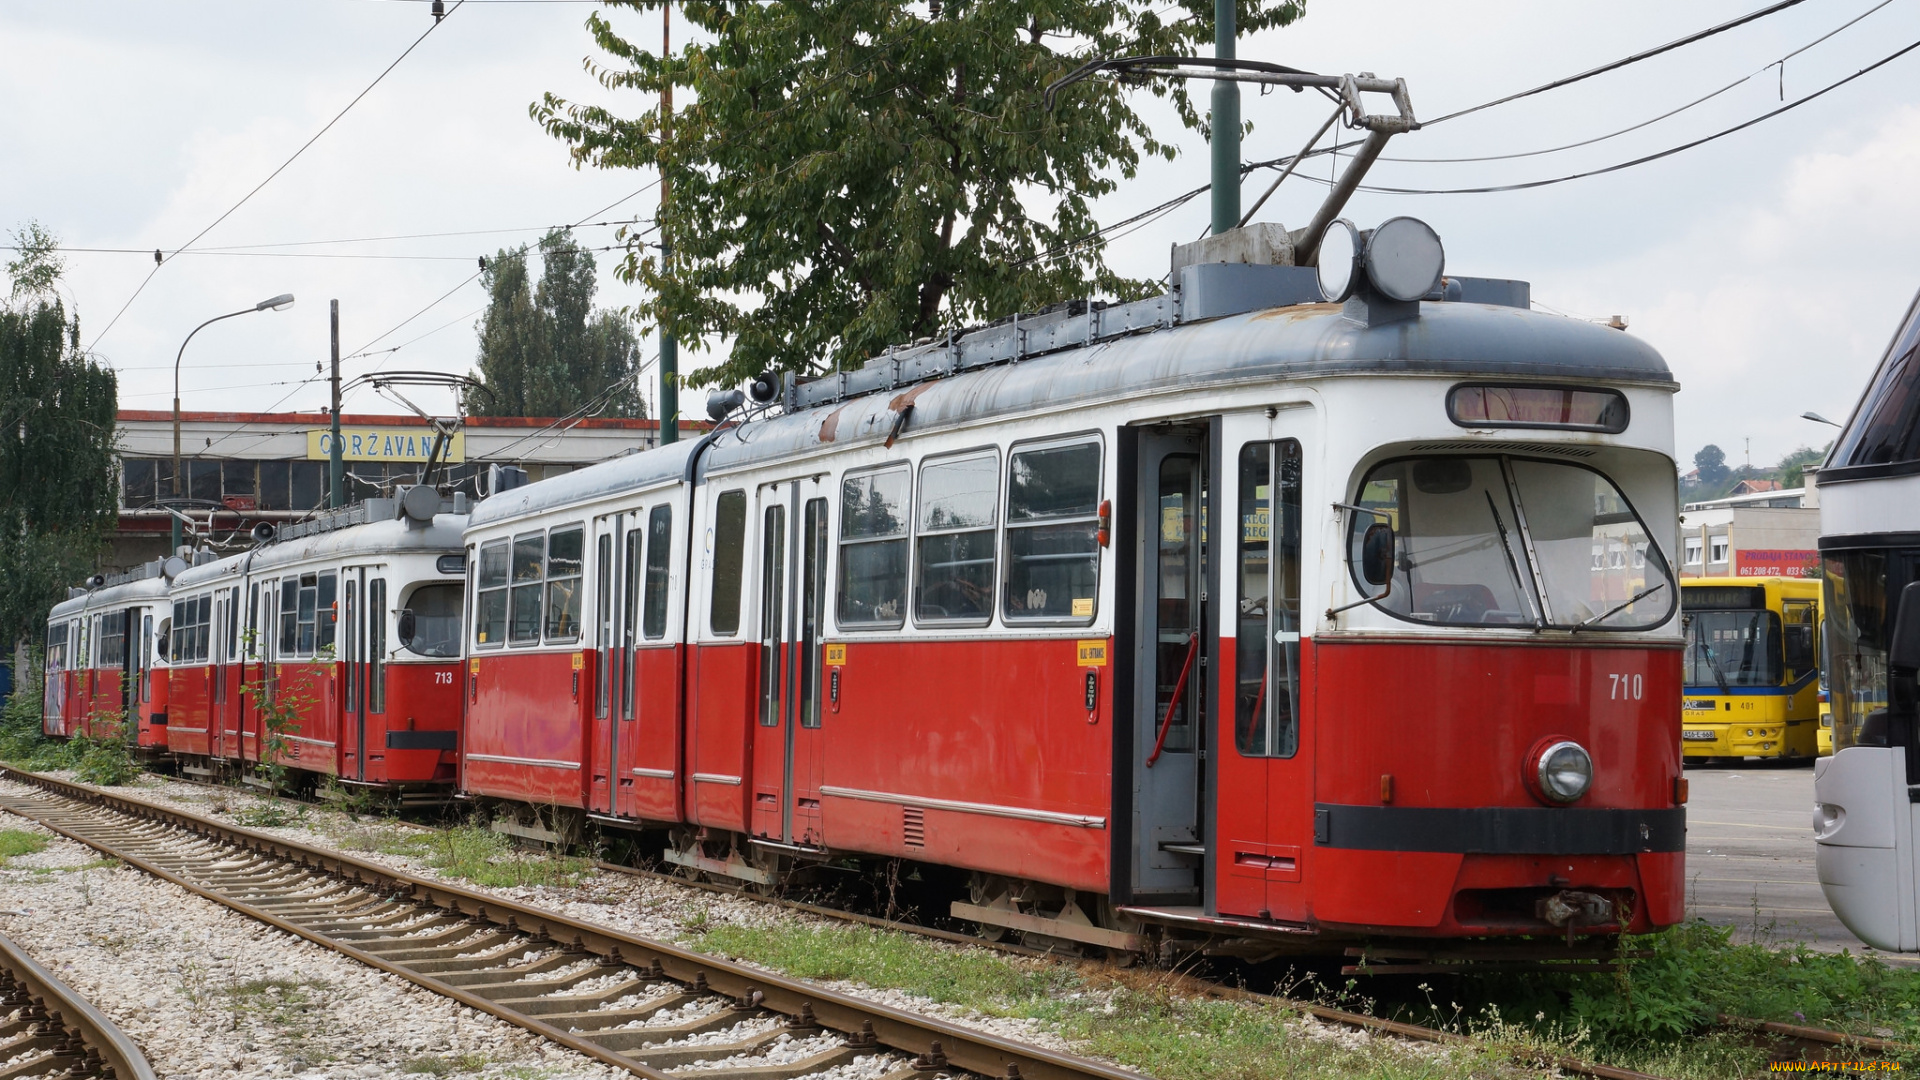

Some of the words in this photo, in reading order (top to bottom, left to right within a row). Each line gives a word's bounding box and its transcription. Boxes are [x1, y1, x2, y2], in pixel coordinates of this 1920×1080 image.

[319, 432, 453, 457] ODRŽAVANE
[1745, 552, 1781, 562] PRODAJA
[1740, 567, 1752, 576] 061
[1786, 567, 1799, 576] 033
[435, 672, 453, 684] 713
[1609, 674, 1643, 700] 710
